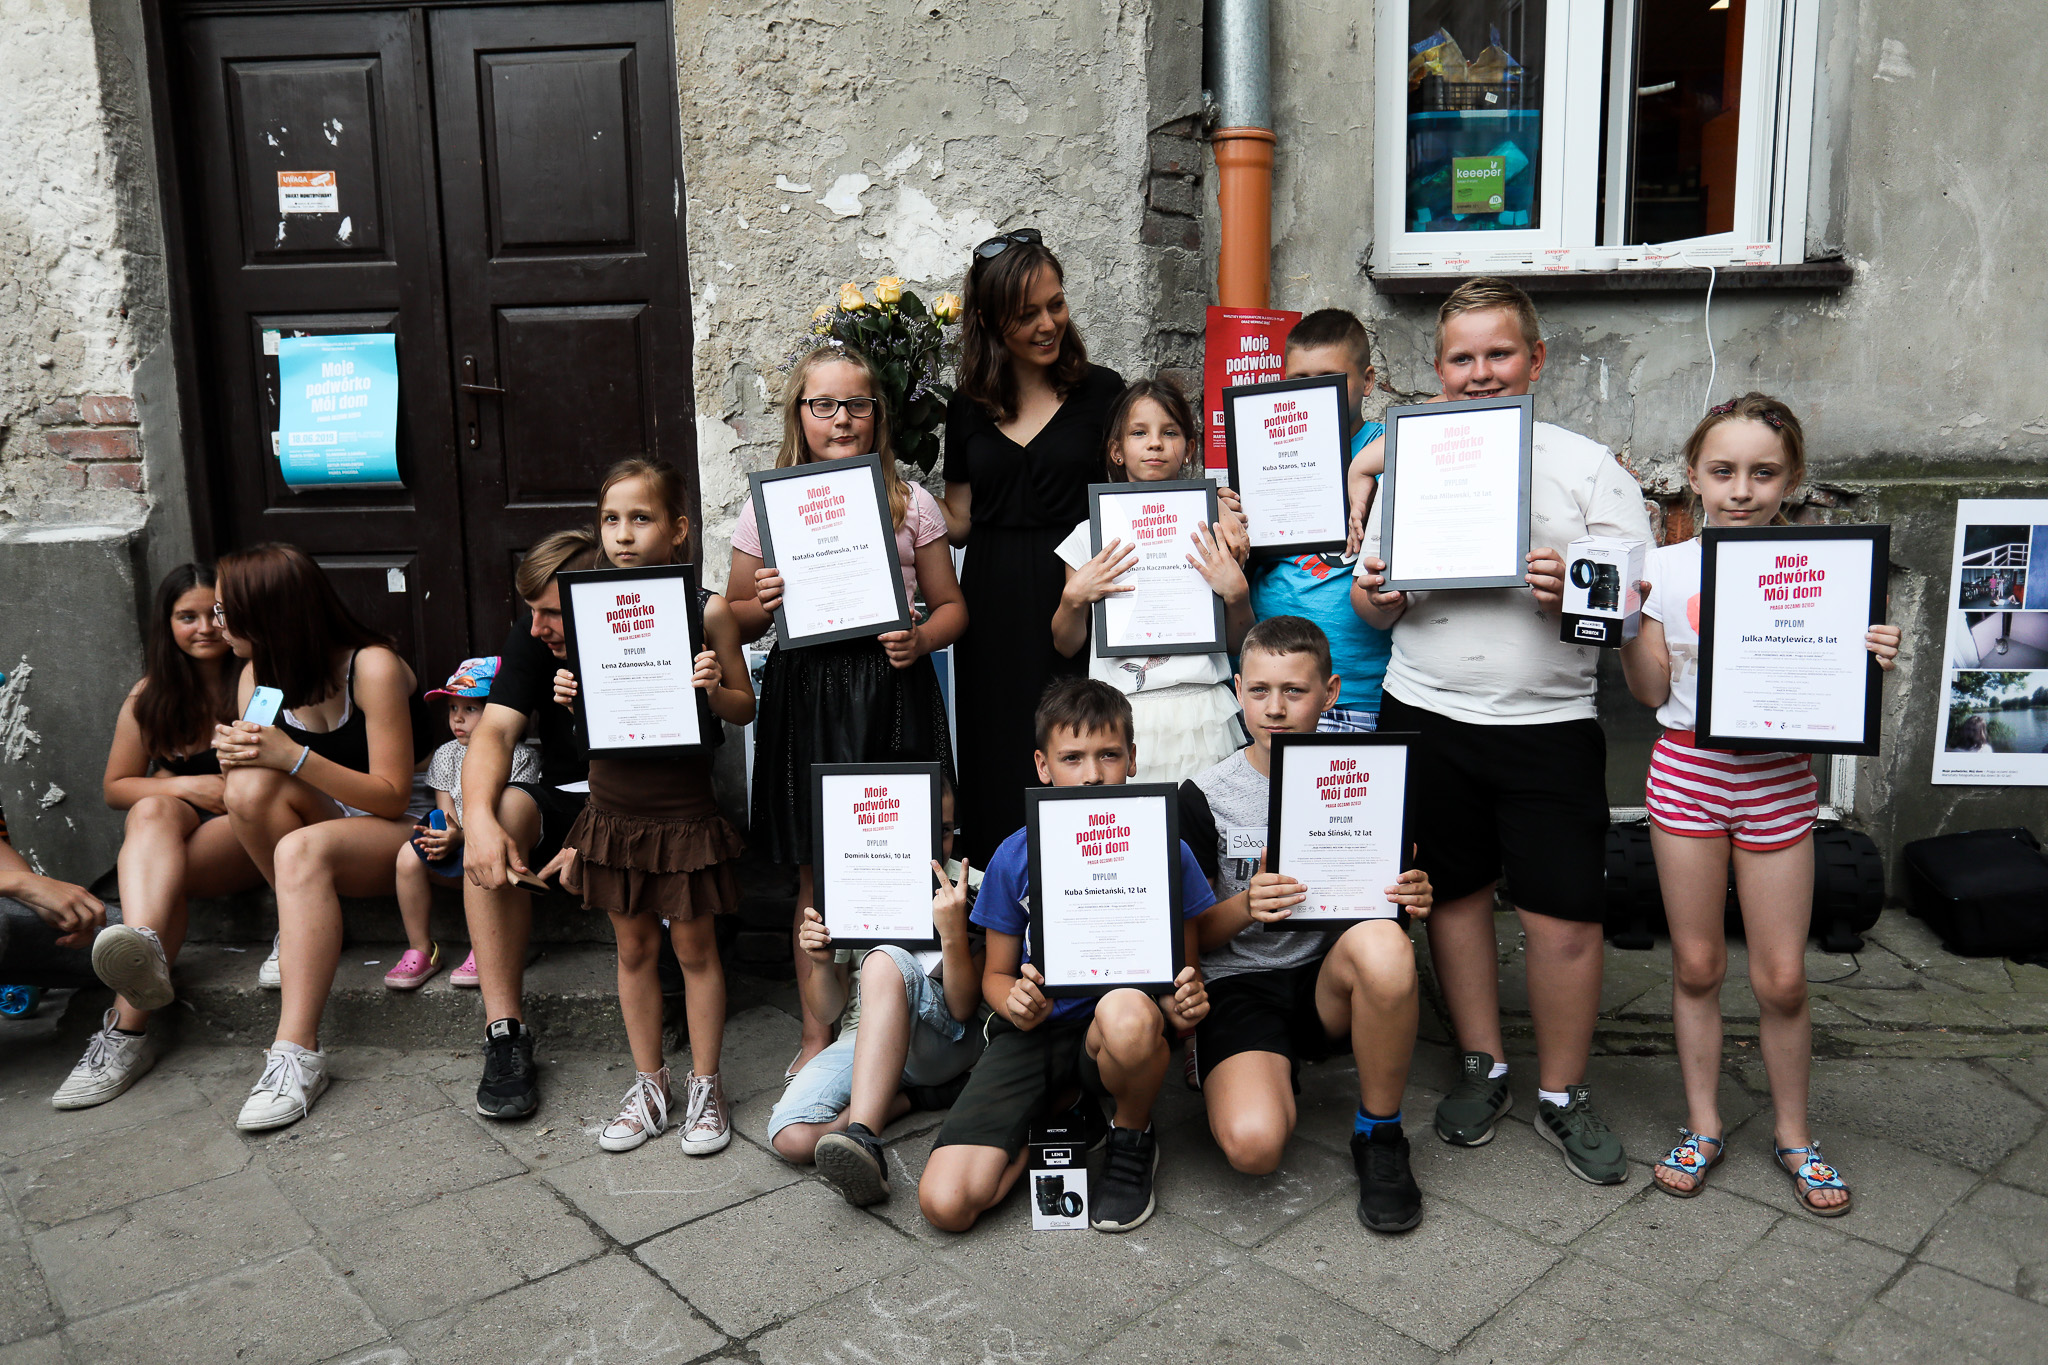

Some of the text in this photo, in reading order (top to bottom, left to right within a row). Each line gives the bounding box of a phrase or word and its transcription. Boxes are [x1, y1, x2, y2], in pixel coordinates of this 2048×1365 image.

[1457, 168, 1502, 179] keeeper
[1240, 334, 1269, 352] Moje
[322, 360, 354, 378] Moje
[1226, 352, 1282, 375] podwórko
[1232, 372, 1280, 386] Mój dom
[306, 376, 371, 399] podwórko
[312, 394, 368, 413] Mój dom
[1274, 400, 1296, 413] Moje
[1264, 411, 1308, 429] podwórko
[292, 433, 334, 443] 18.06.2019
[1269, 424, 1307, 439] Mój dom
[1444, 425, 1470, 438] Moje
[1431, 436, 1484, 455] podwórko
[1436, 450, 1481, 466] Mój dom
[807, 485, 831, 500] Moje
[798, 494, 845, 516] podwórko
[1142, 503, 1165, 515] Moje
[804, 508, 846, 526] Mój dom
[1132, 514, 1178, 530] podwórko
[817, 536, 839, 545] DYPLOM
[1136, 526, 1177, 540] Mój dom
[792, 552, 815, 561] Natalia
[816, 548, 852, 558] Godlewska,
[1775, 554, 1808, 569] Moje
[1759, 569, 1825, 588] podwórko
[616, 592, 640, 606] Moje
[1764, 586, 1822, 601] Mój dom
[606, 604, 655, 623] podwórko
[612, 618, 654, 634] Mój dom
[1765, 635, 1815, 644] Matylewicz,
[624, 648, 646, 656] DYPLOM
[618, 660, 656, 669] Zdanowska,
[1330, 758, 1356, 772] Moje
[1317, 772, 1369, 789] podwórko
[864, 786, 888, 798] Moje
[1321, 786, 1366, 800] Mój dom
[854, 798, 900, 814] podwórko
[858, 812, 898, 825] Mój dom
[1088, 812, 1115, 826] Moje
[1076, 826, 1130, 845] podwórko
[1328, 829, 1352, 837] Śliński,
[1082, 841, 1129, 857] Mój dom
[1093, 873, 1117, 881] DYPLOM
[1085, 886, 1126, 895] Śmietański,
